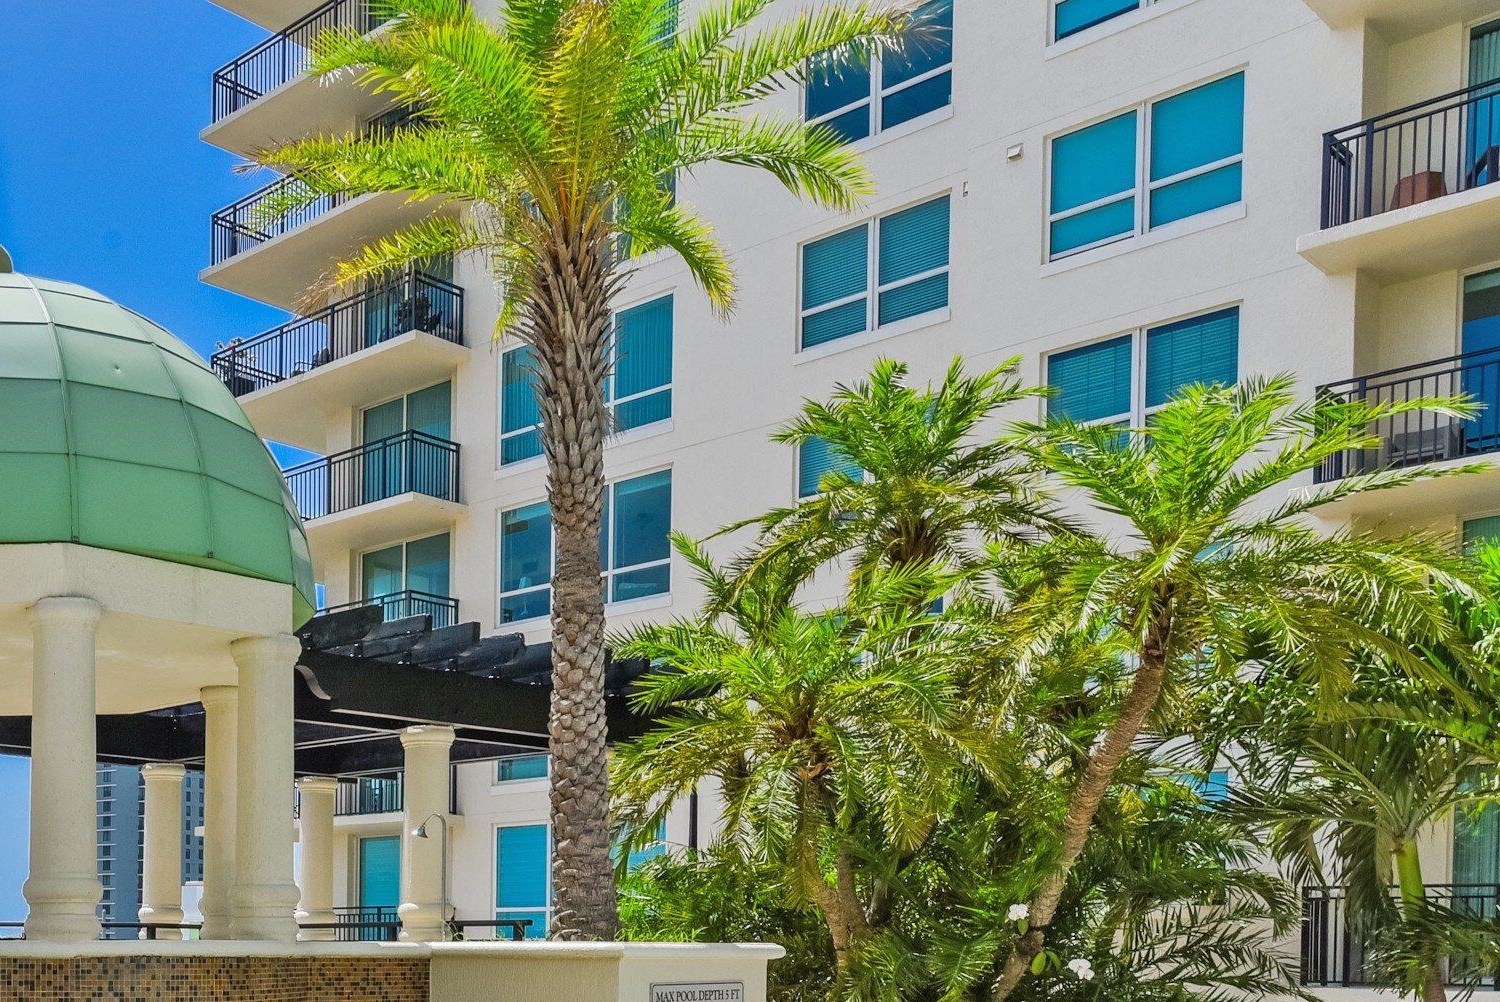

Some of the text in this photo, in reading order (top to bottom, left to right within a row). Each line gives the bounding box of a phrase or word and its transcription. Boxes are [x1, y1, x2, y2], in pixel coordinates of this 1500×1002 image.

[655, 989, 740, 1002] MAX POOL DEPTH 5 FT
